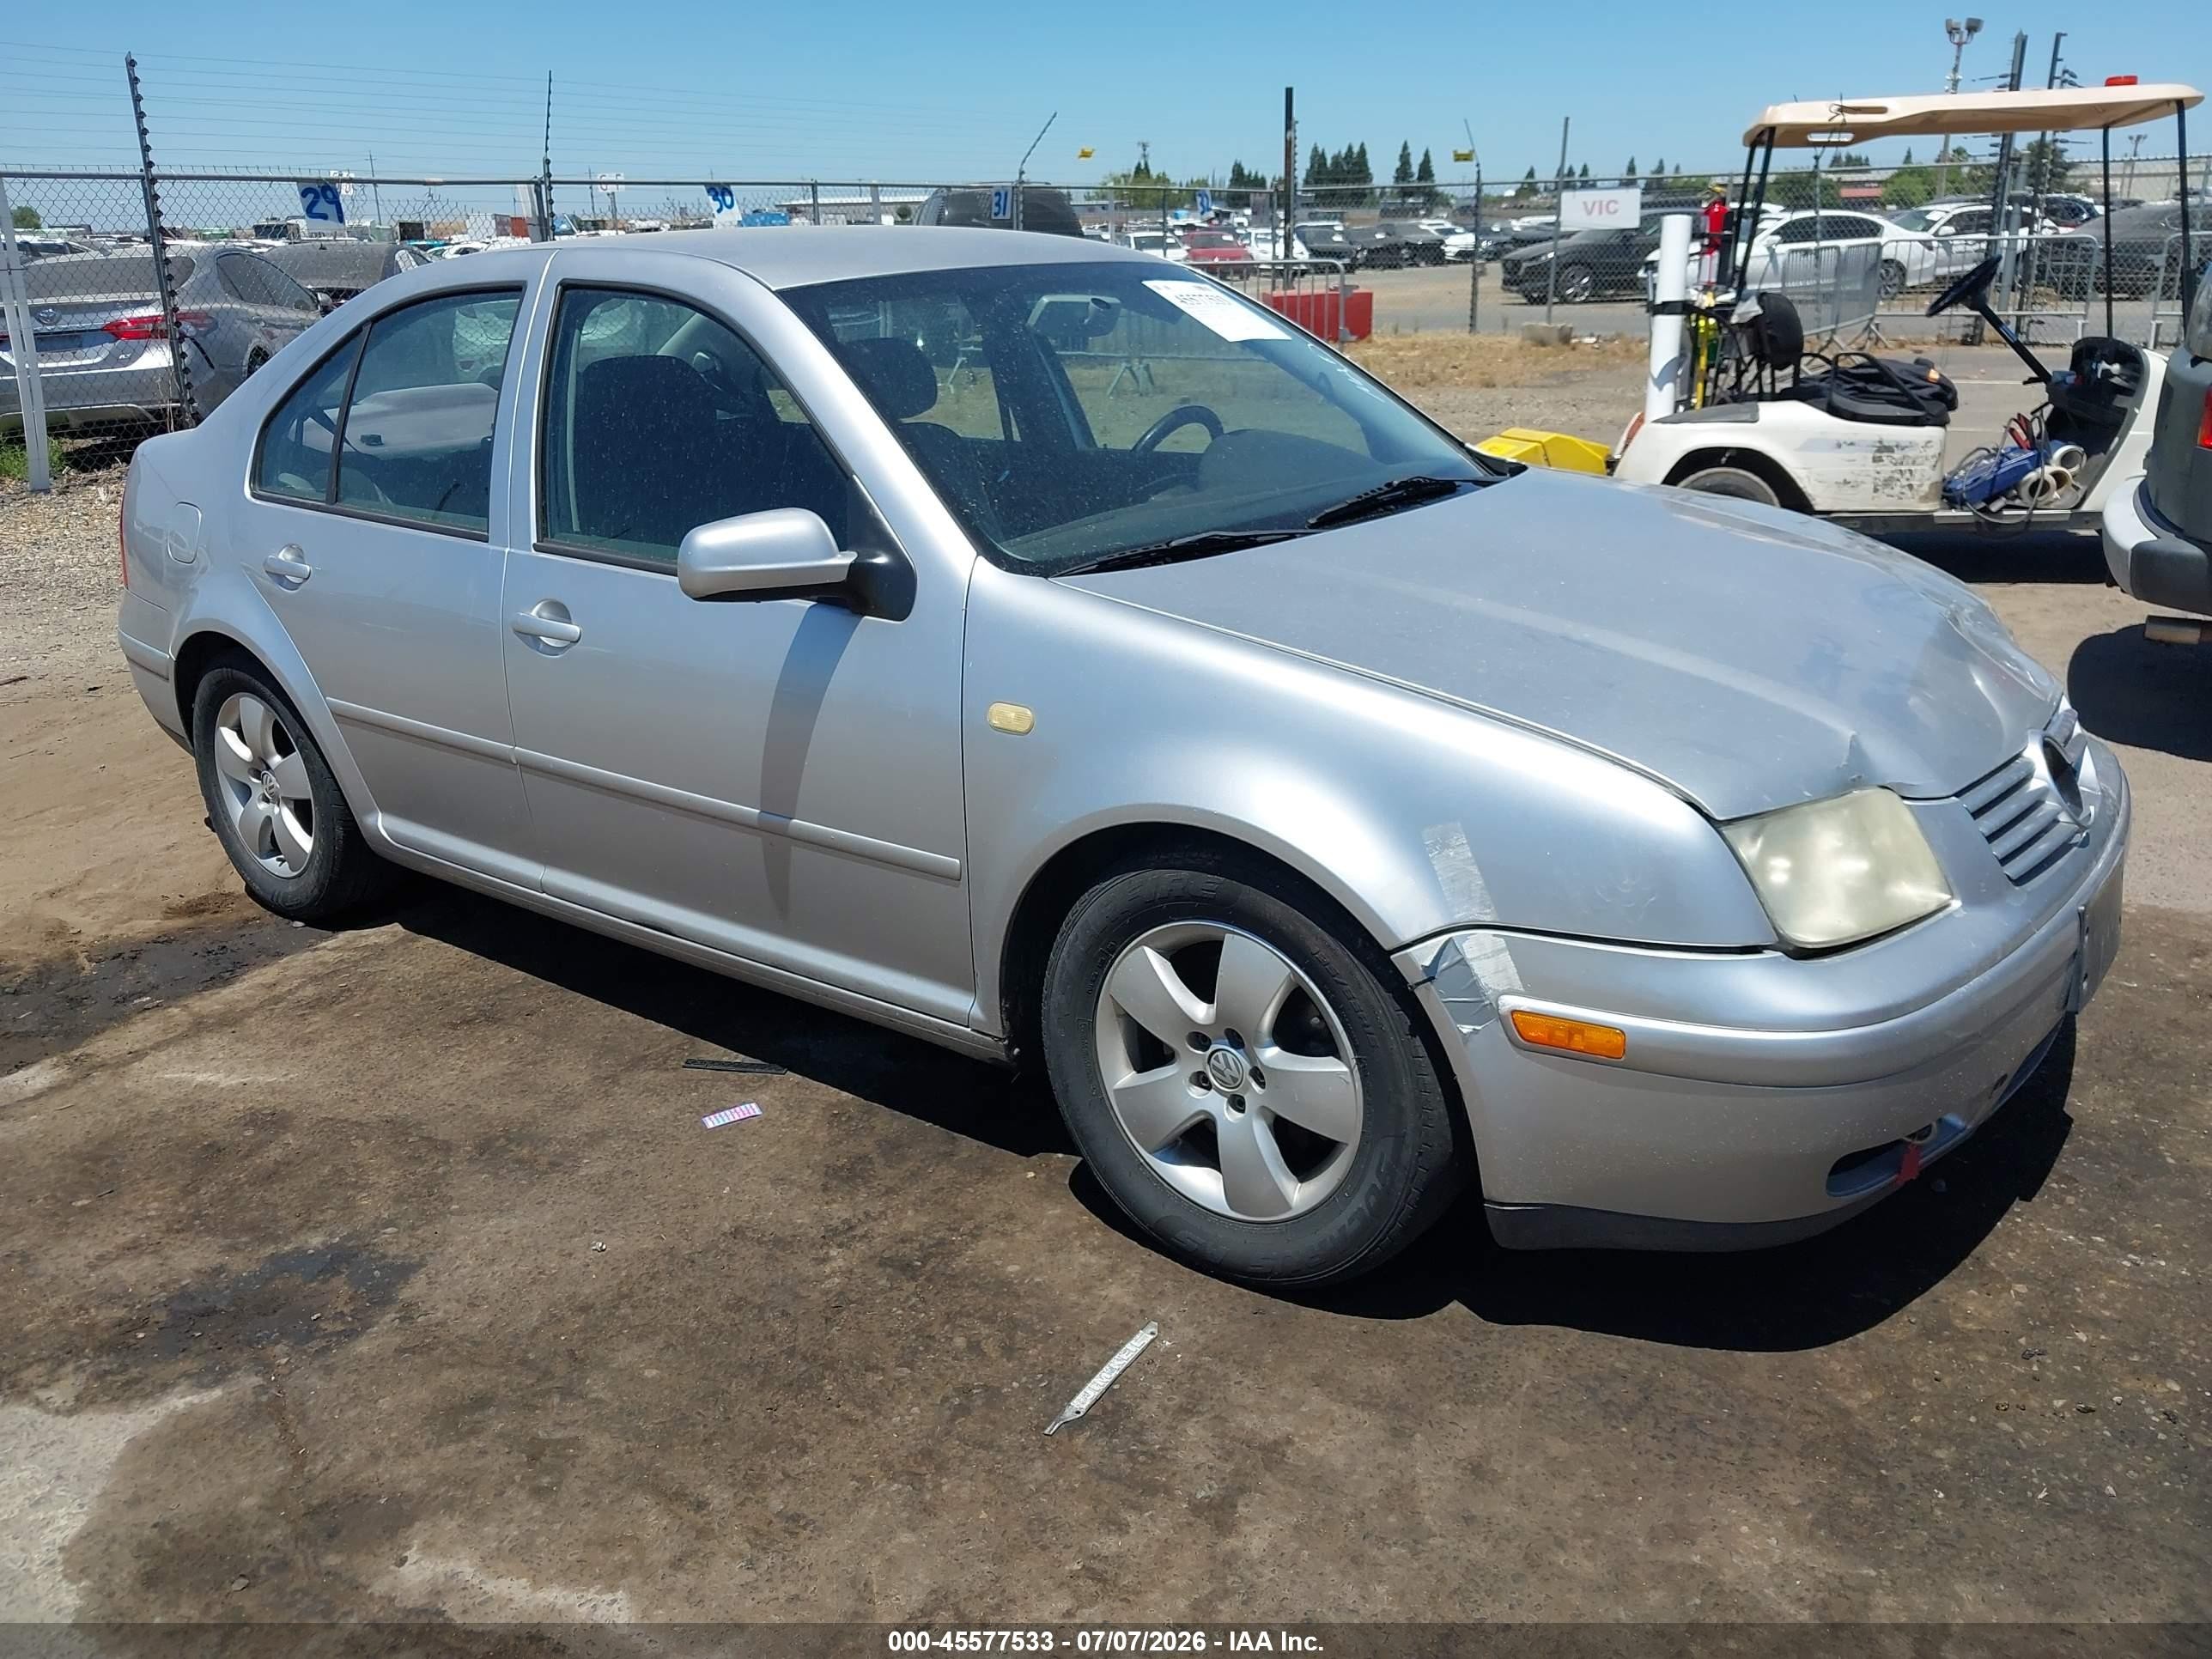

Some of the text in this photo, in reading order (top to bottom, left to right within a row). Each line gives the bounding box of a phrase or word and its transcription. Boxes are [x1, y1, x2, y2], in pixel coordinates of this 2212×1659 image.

[301, 184, 344, 224] 29
[707, 186, 735, 214] 30
[994, 191, 1009, 216] 31
[1582, 199, 1620, 216] VIC
